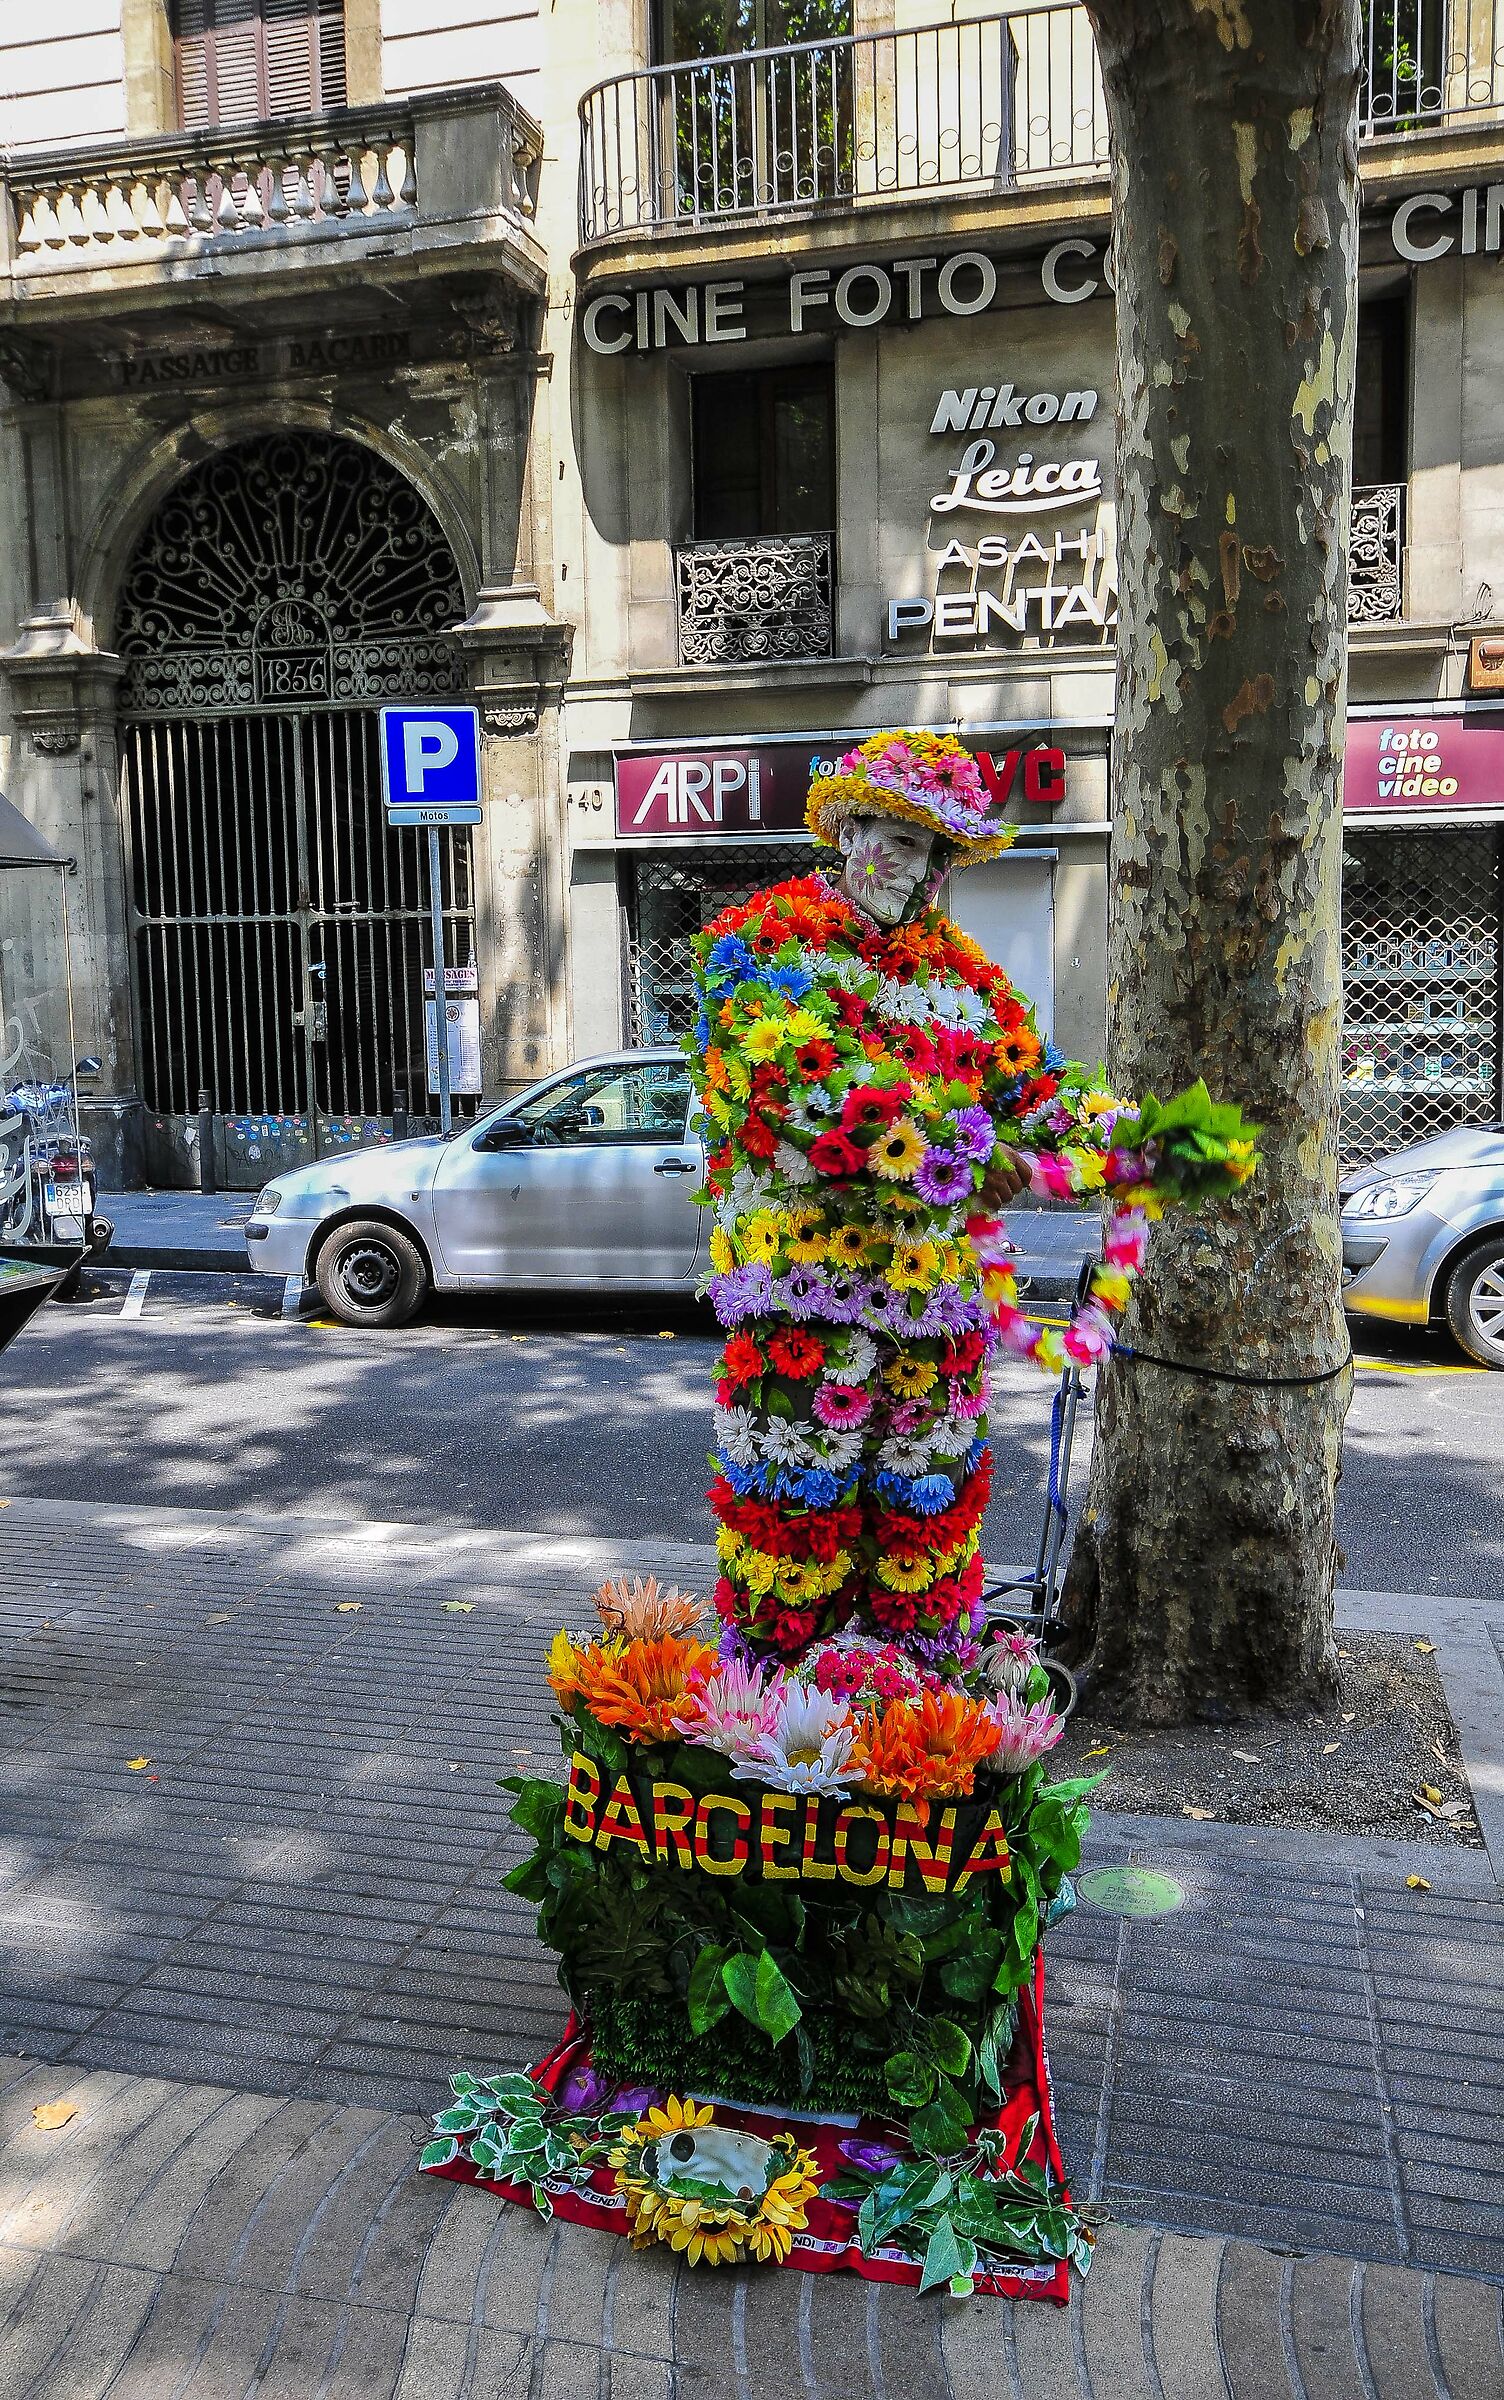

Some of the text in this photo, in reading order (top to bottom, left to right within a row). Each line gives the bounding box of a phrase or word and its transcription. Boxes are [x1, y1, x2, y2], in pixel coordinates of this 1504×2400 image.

[583, 239, 1117, 354] CINE FOTO C
[121, 333, 412, 386] PASSATGE BACARDI
[929, 383, 1099, 434] Nikon
[930, 438, 1102, 514] Leica
[937, 528, 1105, 571] ASAHI
[262, 658, 325, 693] 1856
[1379, 728, 1439, 752] foto
[402, 721, 459, 793] P
[809, 756, 843, 776] fot
[1378, 751, 1442, 775] cine
[975, 747, 1067, 804] VC
[1378, 774, 1459, 797] video
[578, 789, 603, 812] 40
[420, 811, 449, 820] Motos
[425, 969, 475, 979] MSAGES
[563, 1750, 1011, 1893] BARCELONA
[541, 2179, 561, 2193] NDI
[583, 2190, 620, 2207] FENDI
[793, 2236, 816, 2249] NDI
